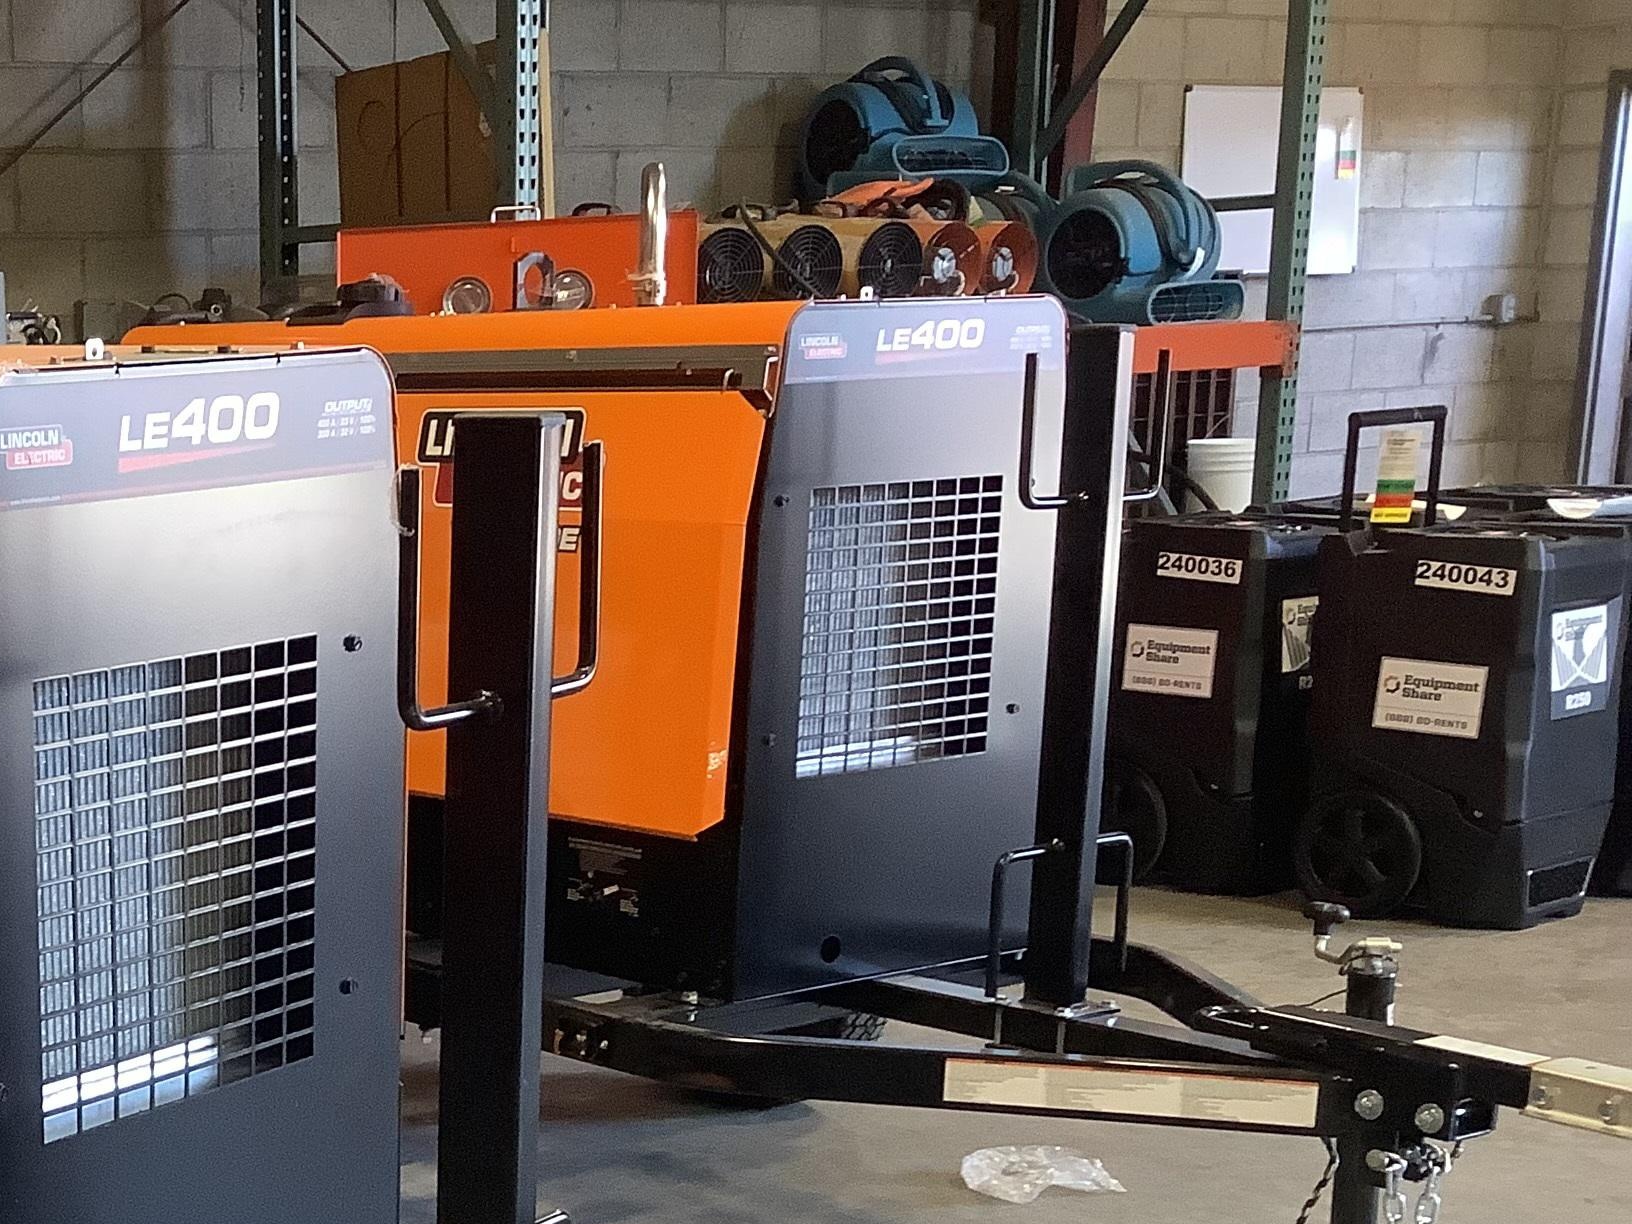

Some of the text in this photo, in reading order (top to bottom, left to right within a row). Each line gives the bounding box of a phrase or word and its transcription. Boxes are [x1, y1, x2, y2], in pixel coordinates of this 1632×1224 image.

[876, 318, 986, 352] LE400
[118, 391, 281, 452] LE400
[0, 429, 59, 450] LINCOLN
[1157, 553, 1237, 578] 240036
[1417, 562, 1510, 588] 240043
[1146, 639, 1212, 655] Equipment
[1145, 651, 1180, 665] Share
[1403, 674, 1480, 693] Equipment
[1402, 688, 1442, 701] Share
